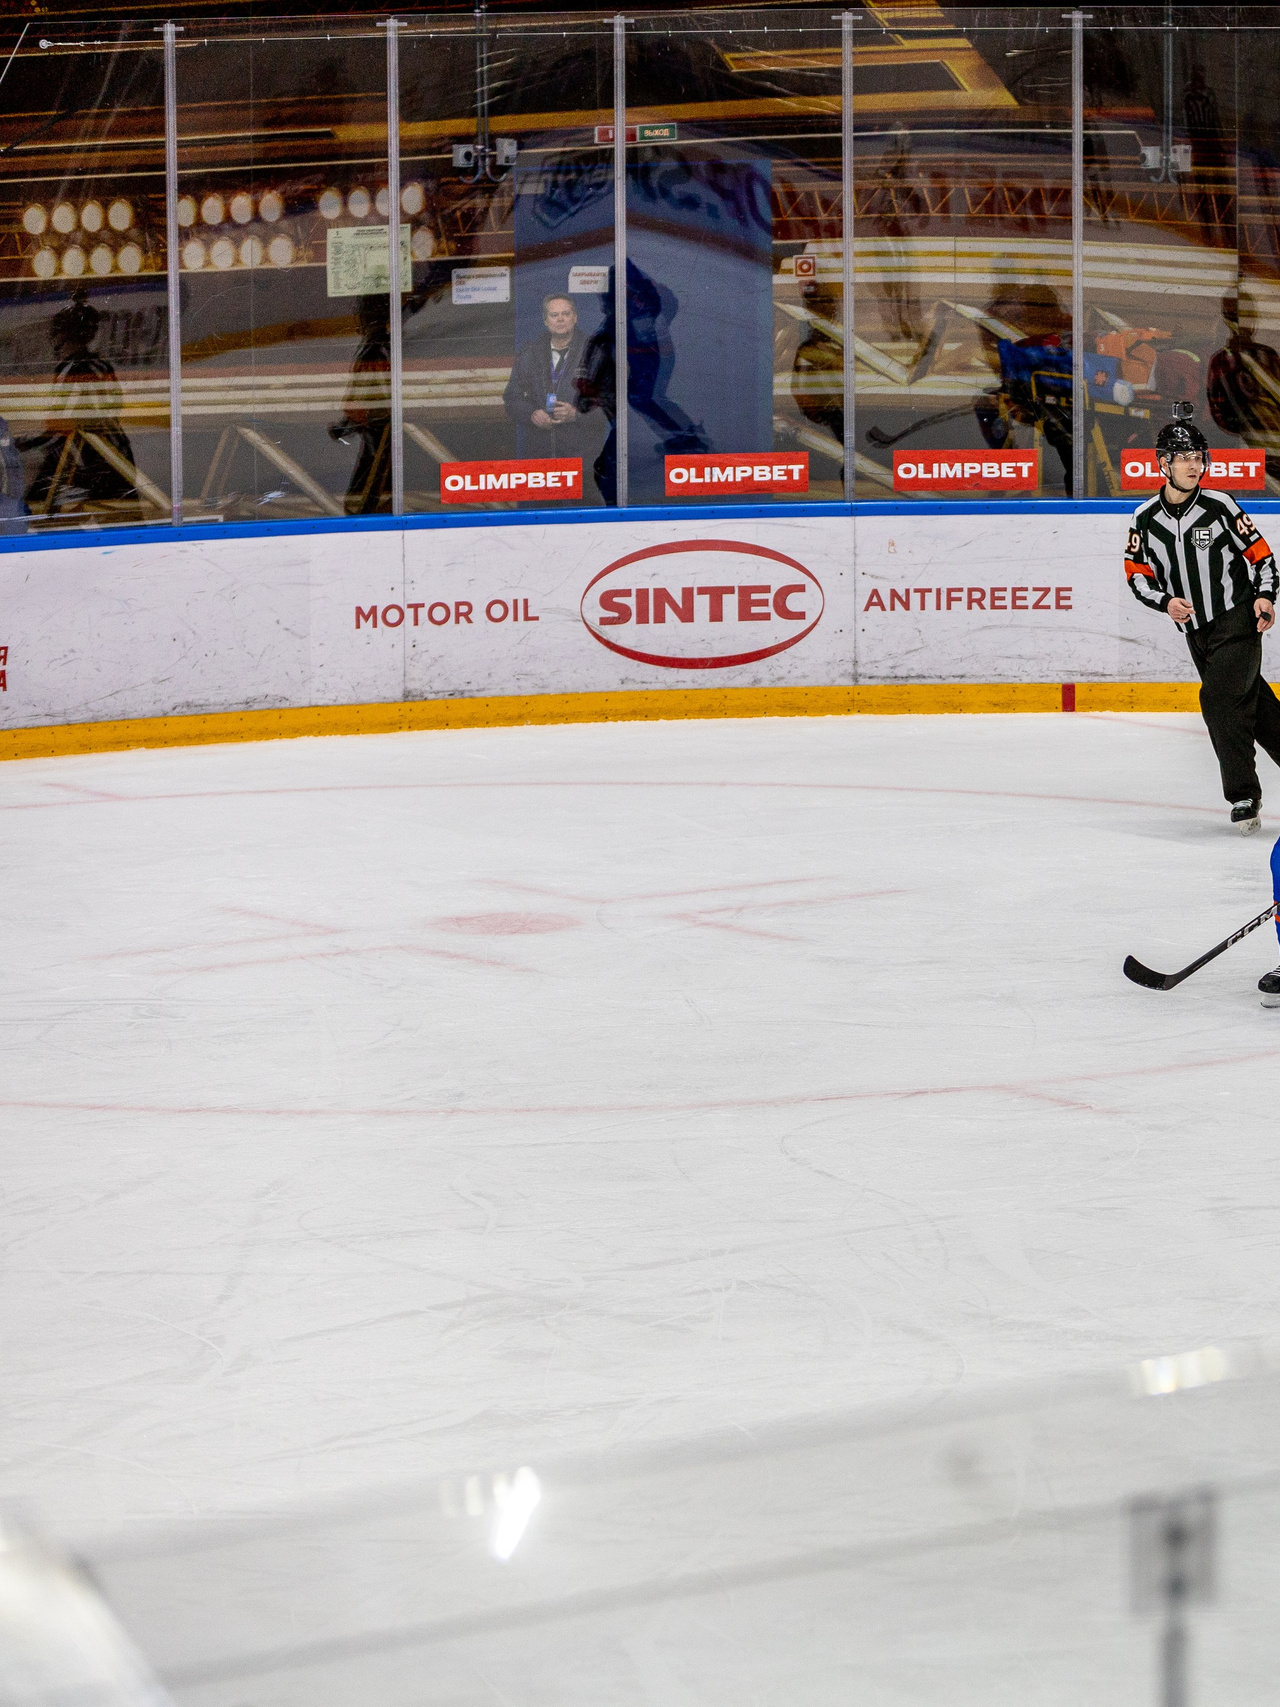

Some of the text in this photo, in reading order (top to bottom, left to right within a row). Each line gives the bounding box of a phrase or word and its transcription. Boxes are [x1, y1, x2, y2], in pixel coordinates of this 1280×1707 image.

[669, 465, 805, 484] OLIMPBET
[897, 462, 1034, 479] OLIMPBET
[1124, 461, 1261, 478] OLBET
[444, 471, 578, 490] OLIMPBET
[1236, 513, 1256, 535] 49
[599, 584, 806, 626] SINTEC
[863, 586, 1073, 612] ANTIFREEZE
[355, 599, 539, 629] MOTOR OIL
